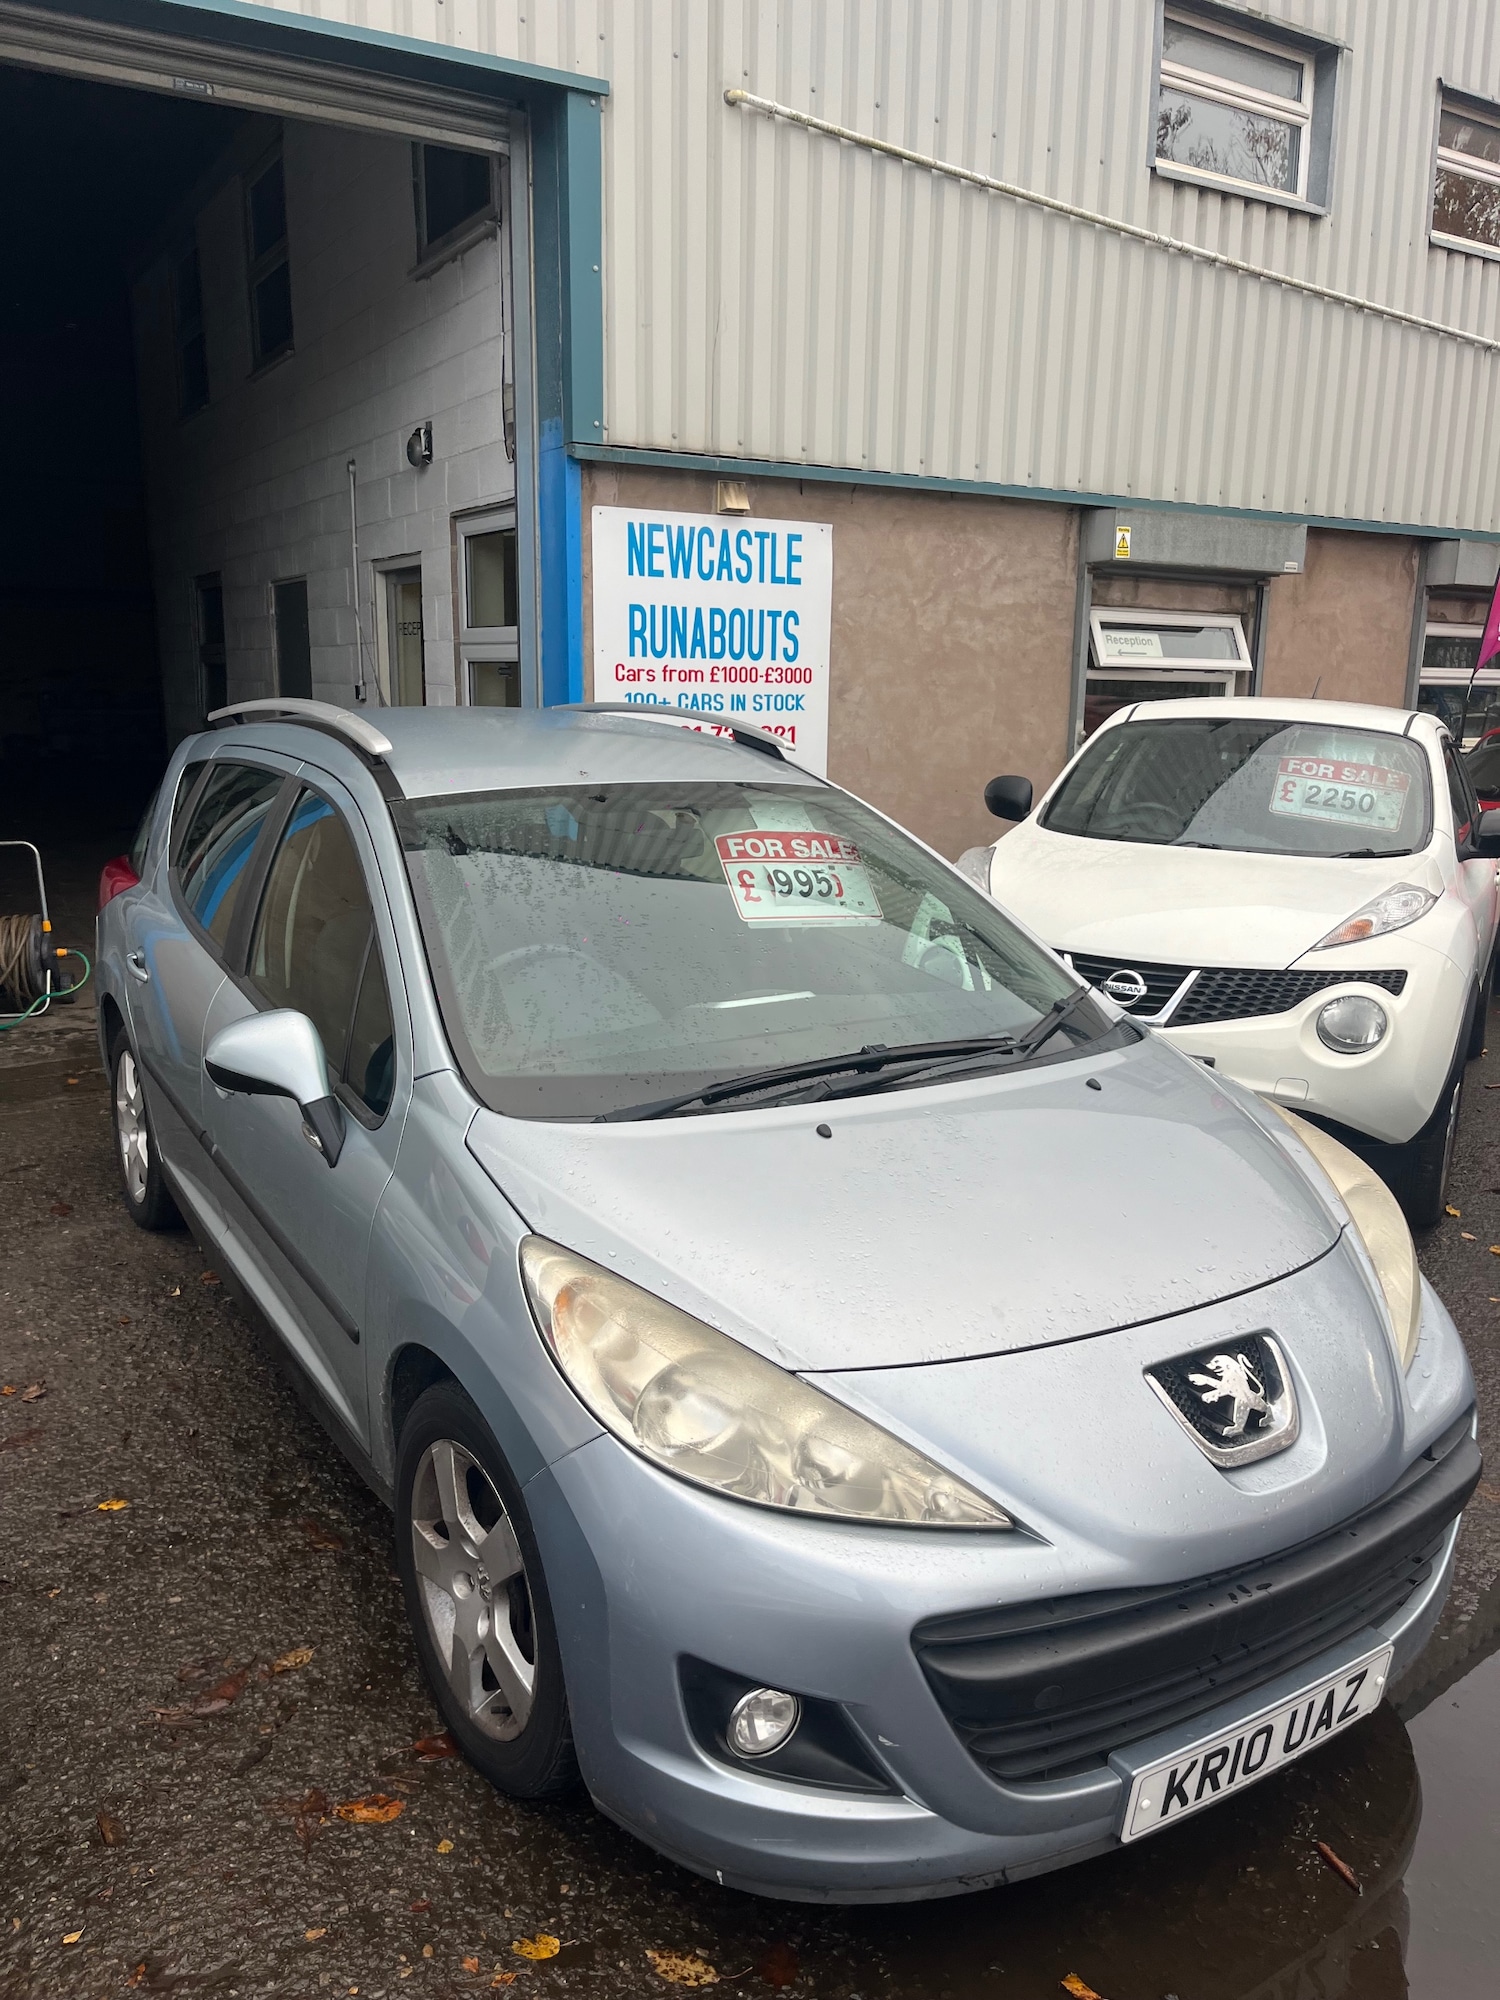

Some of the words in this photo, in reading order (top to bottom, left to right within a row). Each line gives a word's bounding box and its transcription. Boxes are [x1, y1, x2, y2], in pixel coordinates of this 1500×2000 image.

[627, 521, 803, 586] NEWCASTLE
[628, 603, 800, 663] RUNABOUTS
[1105, 634, 1153, 647] Reception
[615, 663, 656, 682] Cars
[661, 664, 704, 683] from
[709, 666, 813, 684] £1000-£3000
[677, 693, 724, 711] CARS
[731, 694, 747, 711] IN
[752, 694, 806, 712] STOCK
[1287, 759, 1335, 779] FOR
[1340, 766, 1400, 788] SALE
[727, 838, 787, 857] FOR
[791, 838, 857, 860] SALE
[1105, 983, 1142, 993] NISSAN
[1160, 1724, 1274, 1818] KR10
[1283, 1668, 1368, 1754] UAZ
